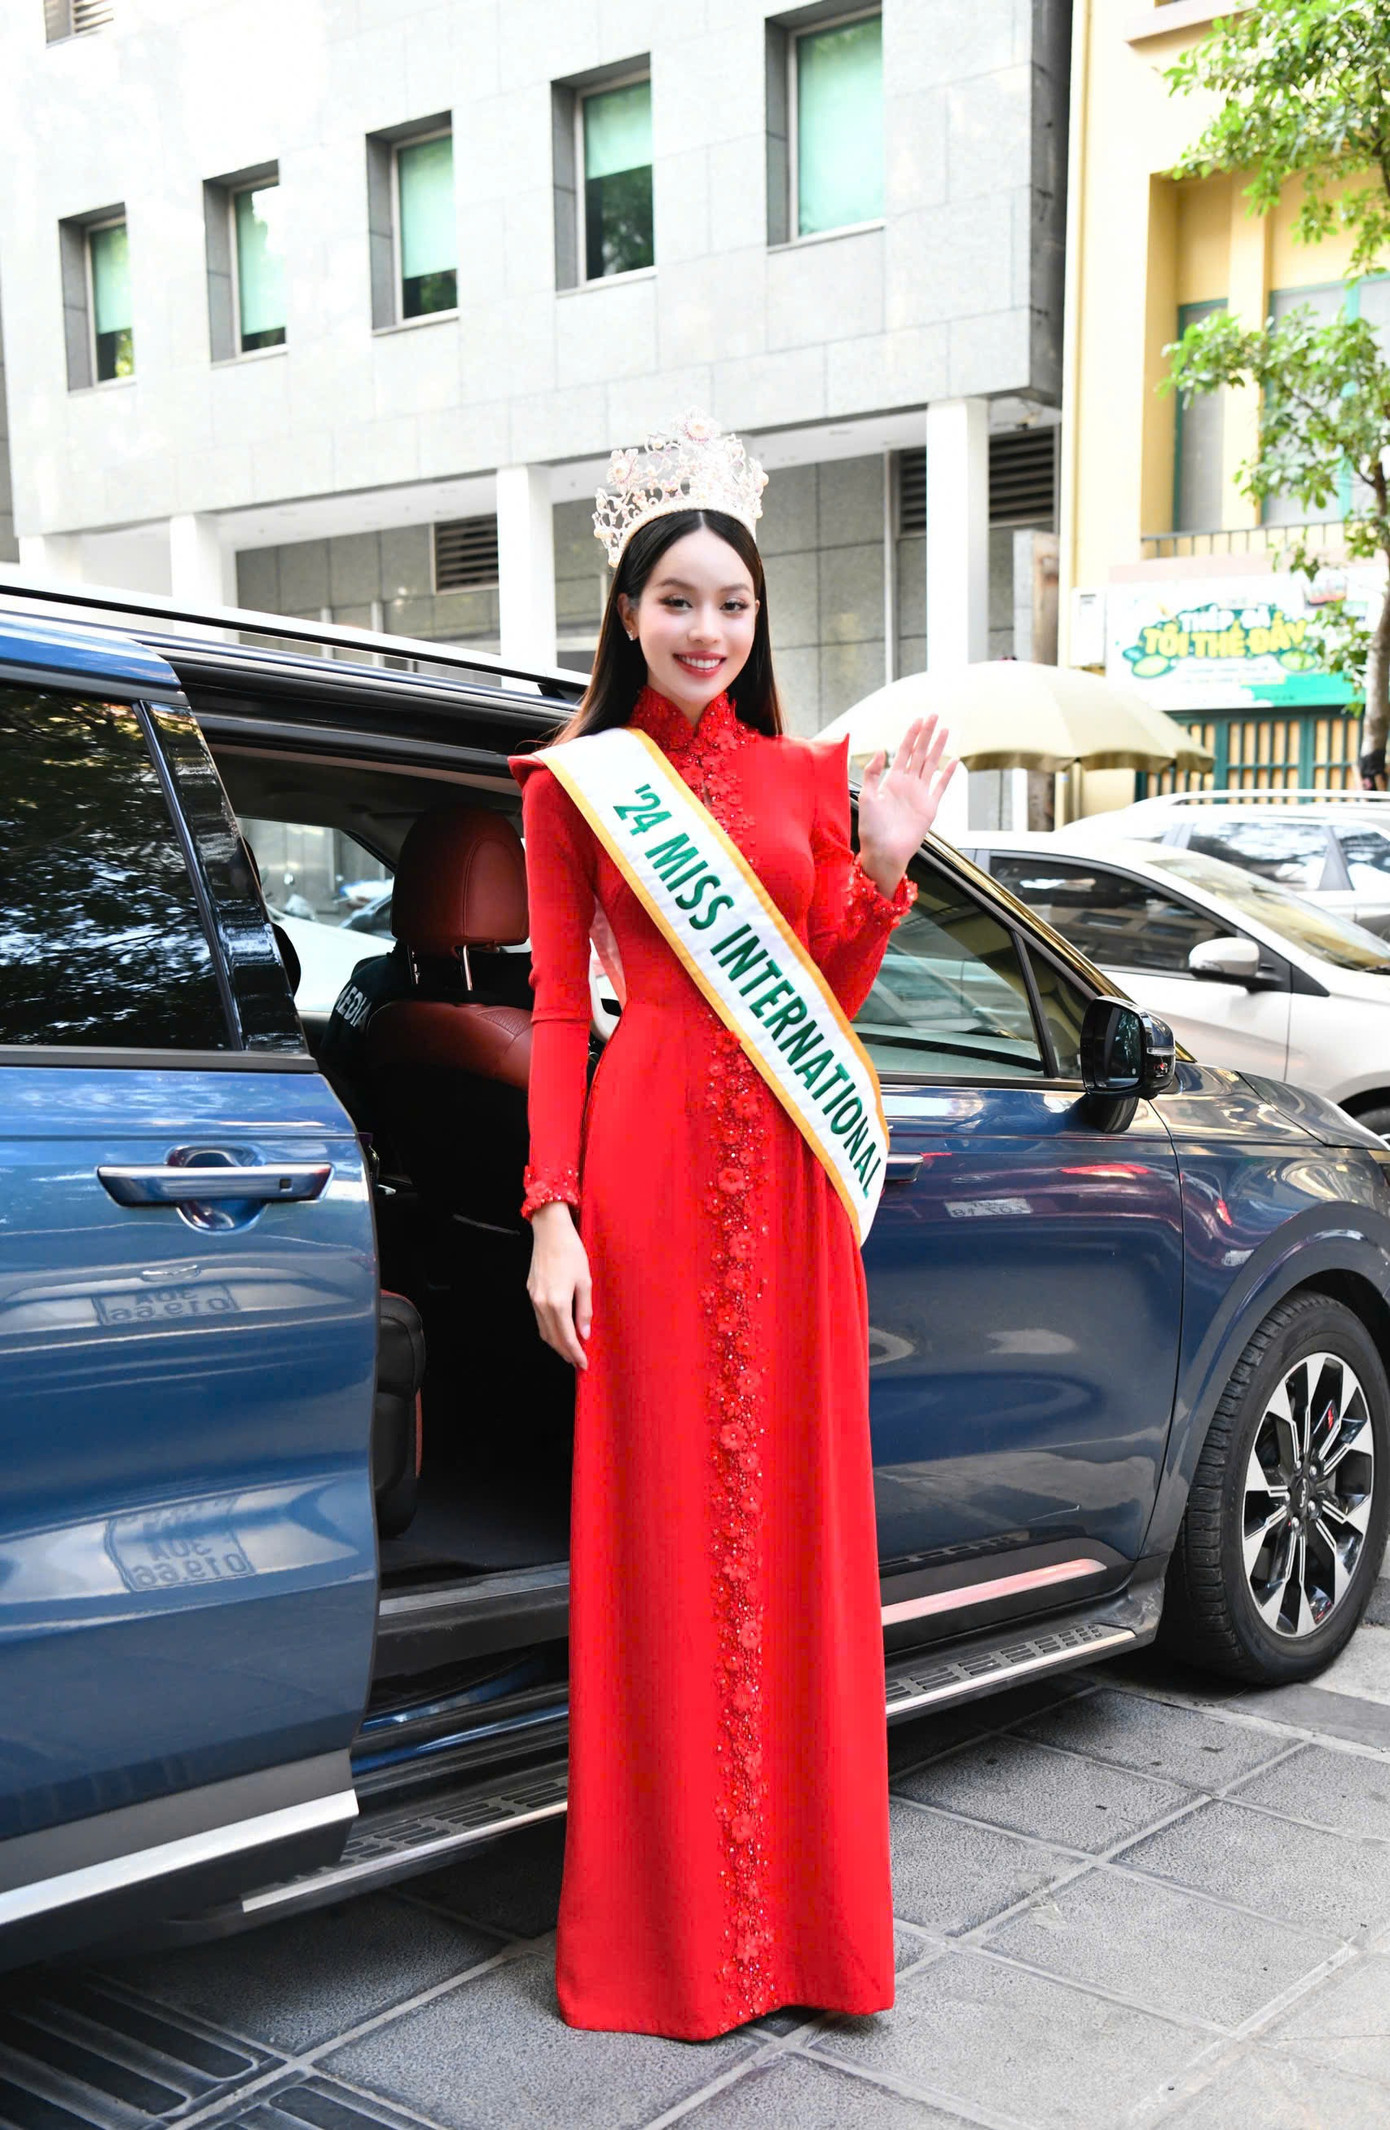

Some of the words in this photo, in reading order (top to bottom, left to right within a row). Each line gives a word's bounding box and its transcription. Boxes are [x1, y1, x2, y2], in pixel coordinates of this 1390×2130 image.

[613, 783, 672, 836] '24
[644, 832, 735, 931] MISS
[710, 923, 881, 1199] INTERNATIONAL
